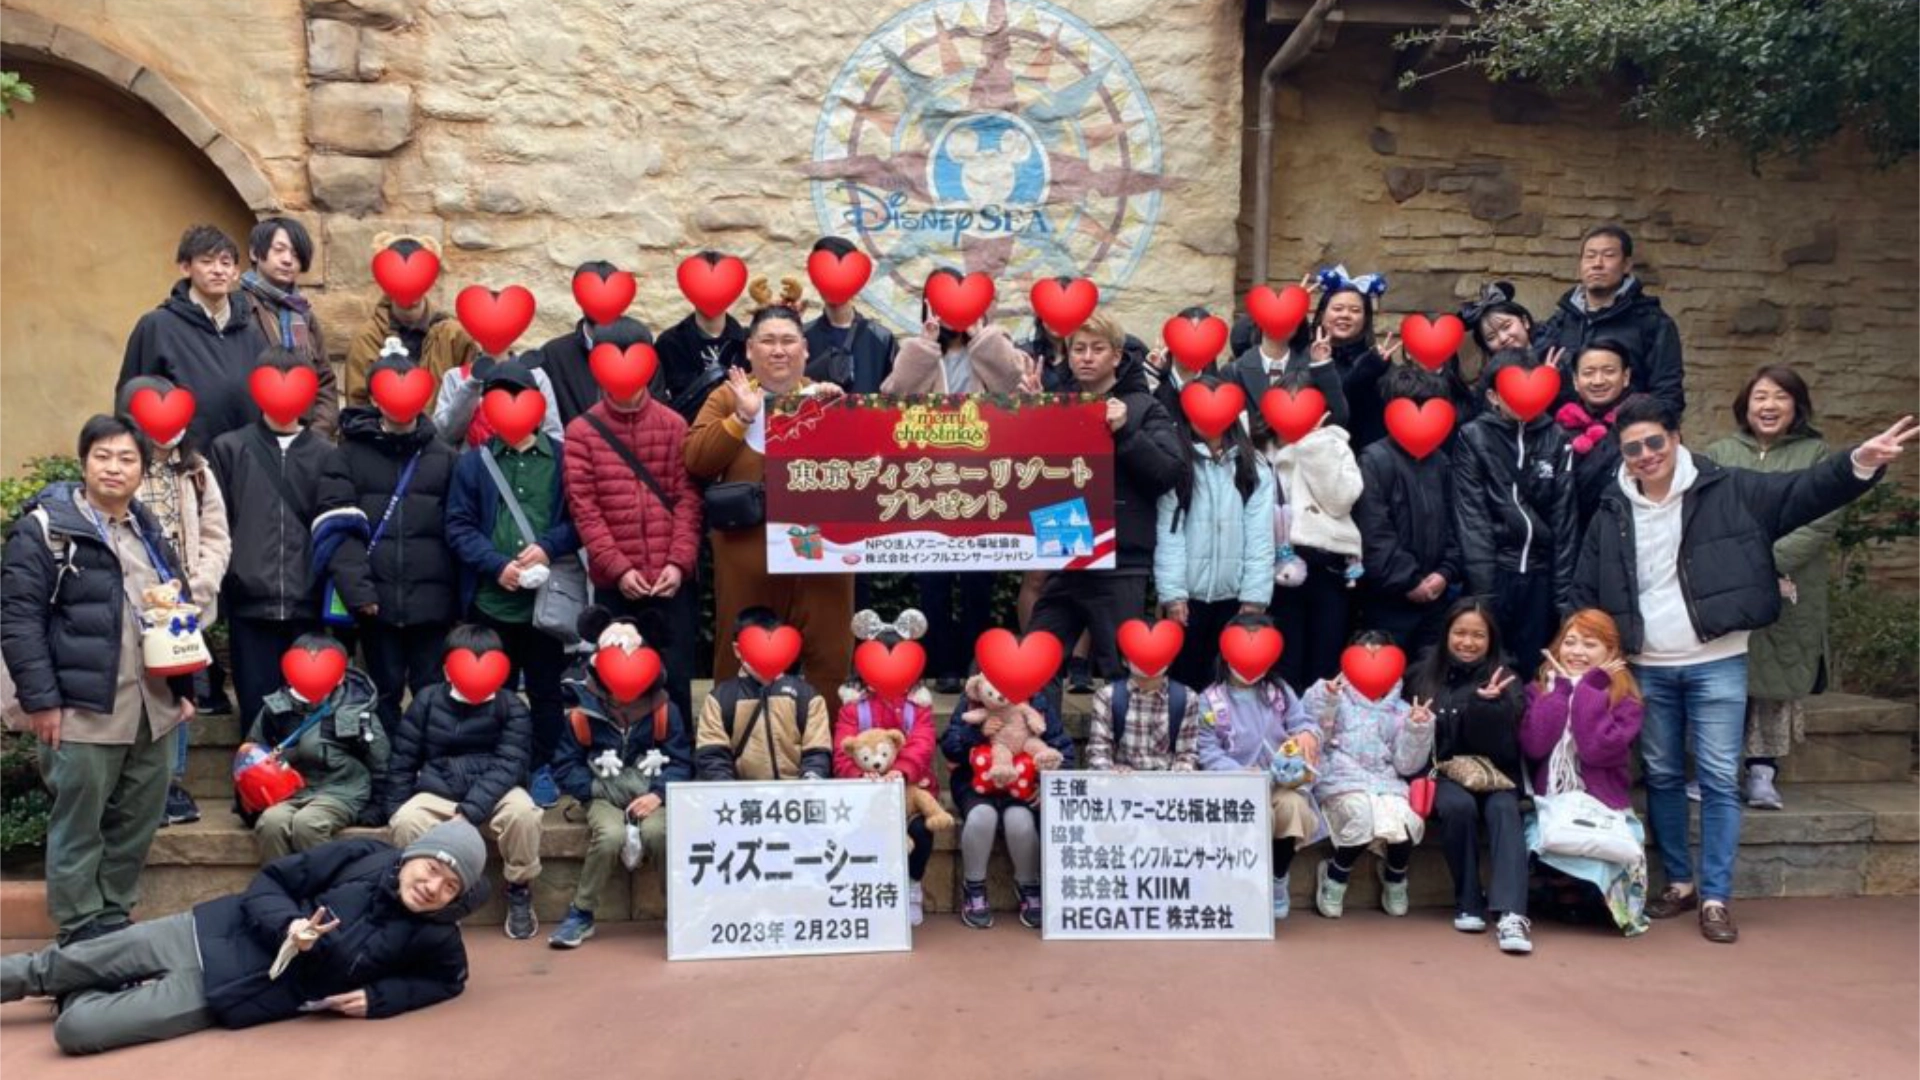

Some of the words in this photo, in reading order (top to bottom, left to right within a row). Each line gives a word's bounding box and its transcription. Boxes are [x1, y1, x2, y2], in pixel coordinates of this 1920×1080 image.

[787, 457, 1093, 491] 東京ディズニーリゾート
[877, 489, 1007, 521] プレゼント
[865, 537, 1020, 550] NPO法人アニーこども福祉協会
[865, 552, 1034, 565] 株式会社インフルエンサージャパン
[1050, 778, 1087, 797] 主催
[1051, 825, 1085, 844] 協賛
[688, 838, 878, 886] ディズニーシー
[828, 883, 899, 909] ご招待
[1061, 876, 1128, 900] 株式会社
[1137, 877, 1190, 900] KIIM
[1062, 906, 1160, 930] REGATE
[1166, 905, 1233, 930] 株式会社
[711, 922, 786, 943] 2023年
[794, 918, 869, 941] 2月23日
